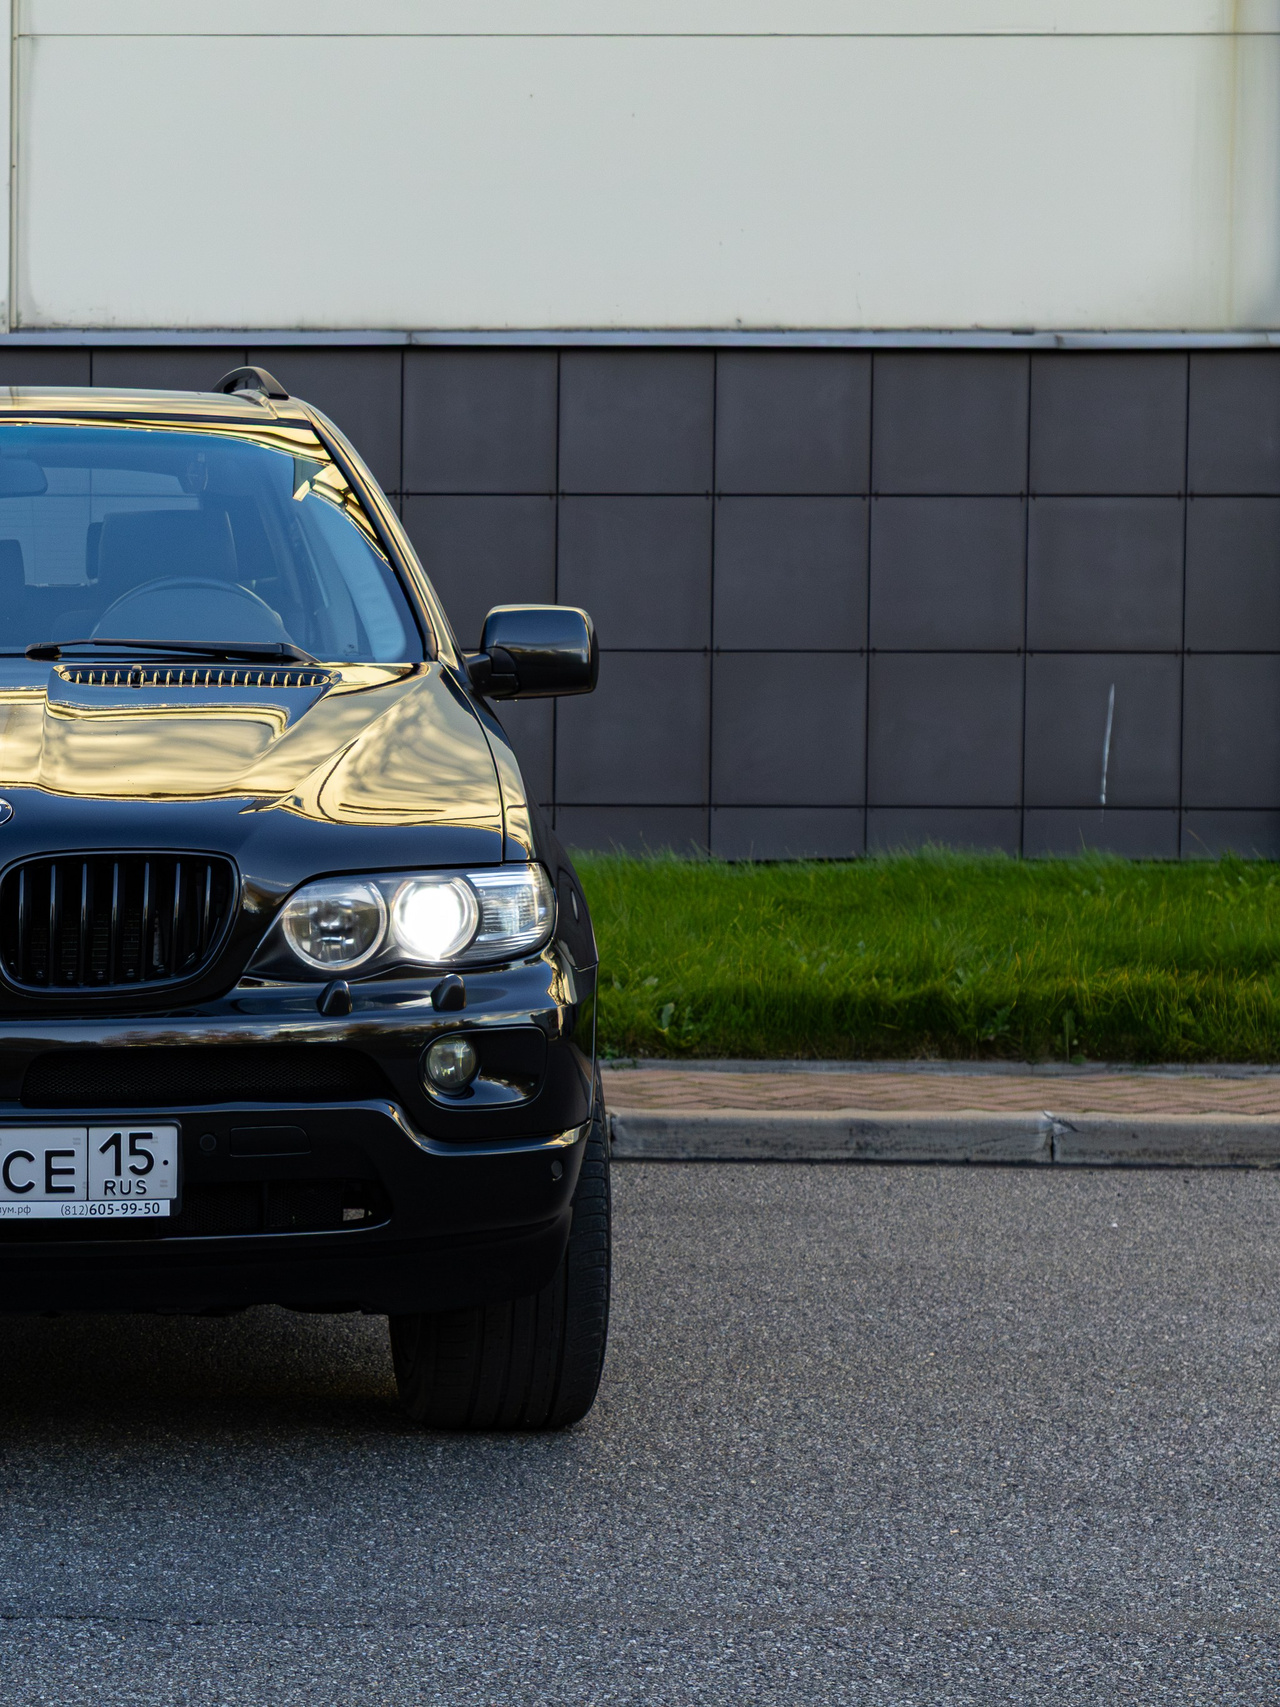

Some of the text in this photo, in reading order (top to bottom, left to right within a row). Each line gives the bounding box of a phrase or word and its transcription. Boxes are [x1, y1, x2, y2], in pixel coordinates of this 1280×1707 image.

[98, 1132, 155, 1177] 15
[104, 1180, 147, 1195] RUS
[60, 1202, 160, 1216] (812)605-99-50
